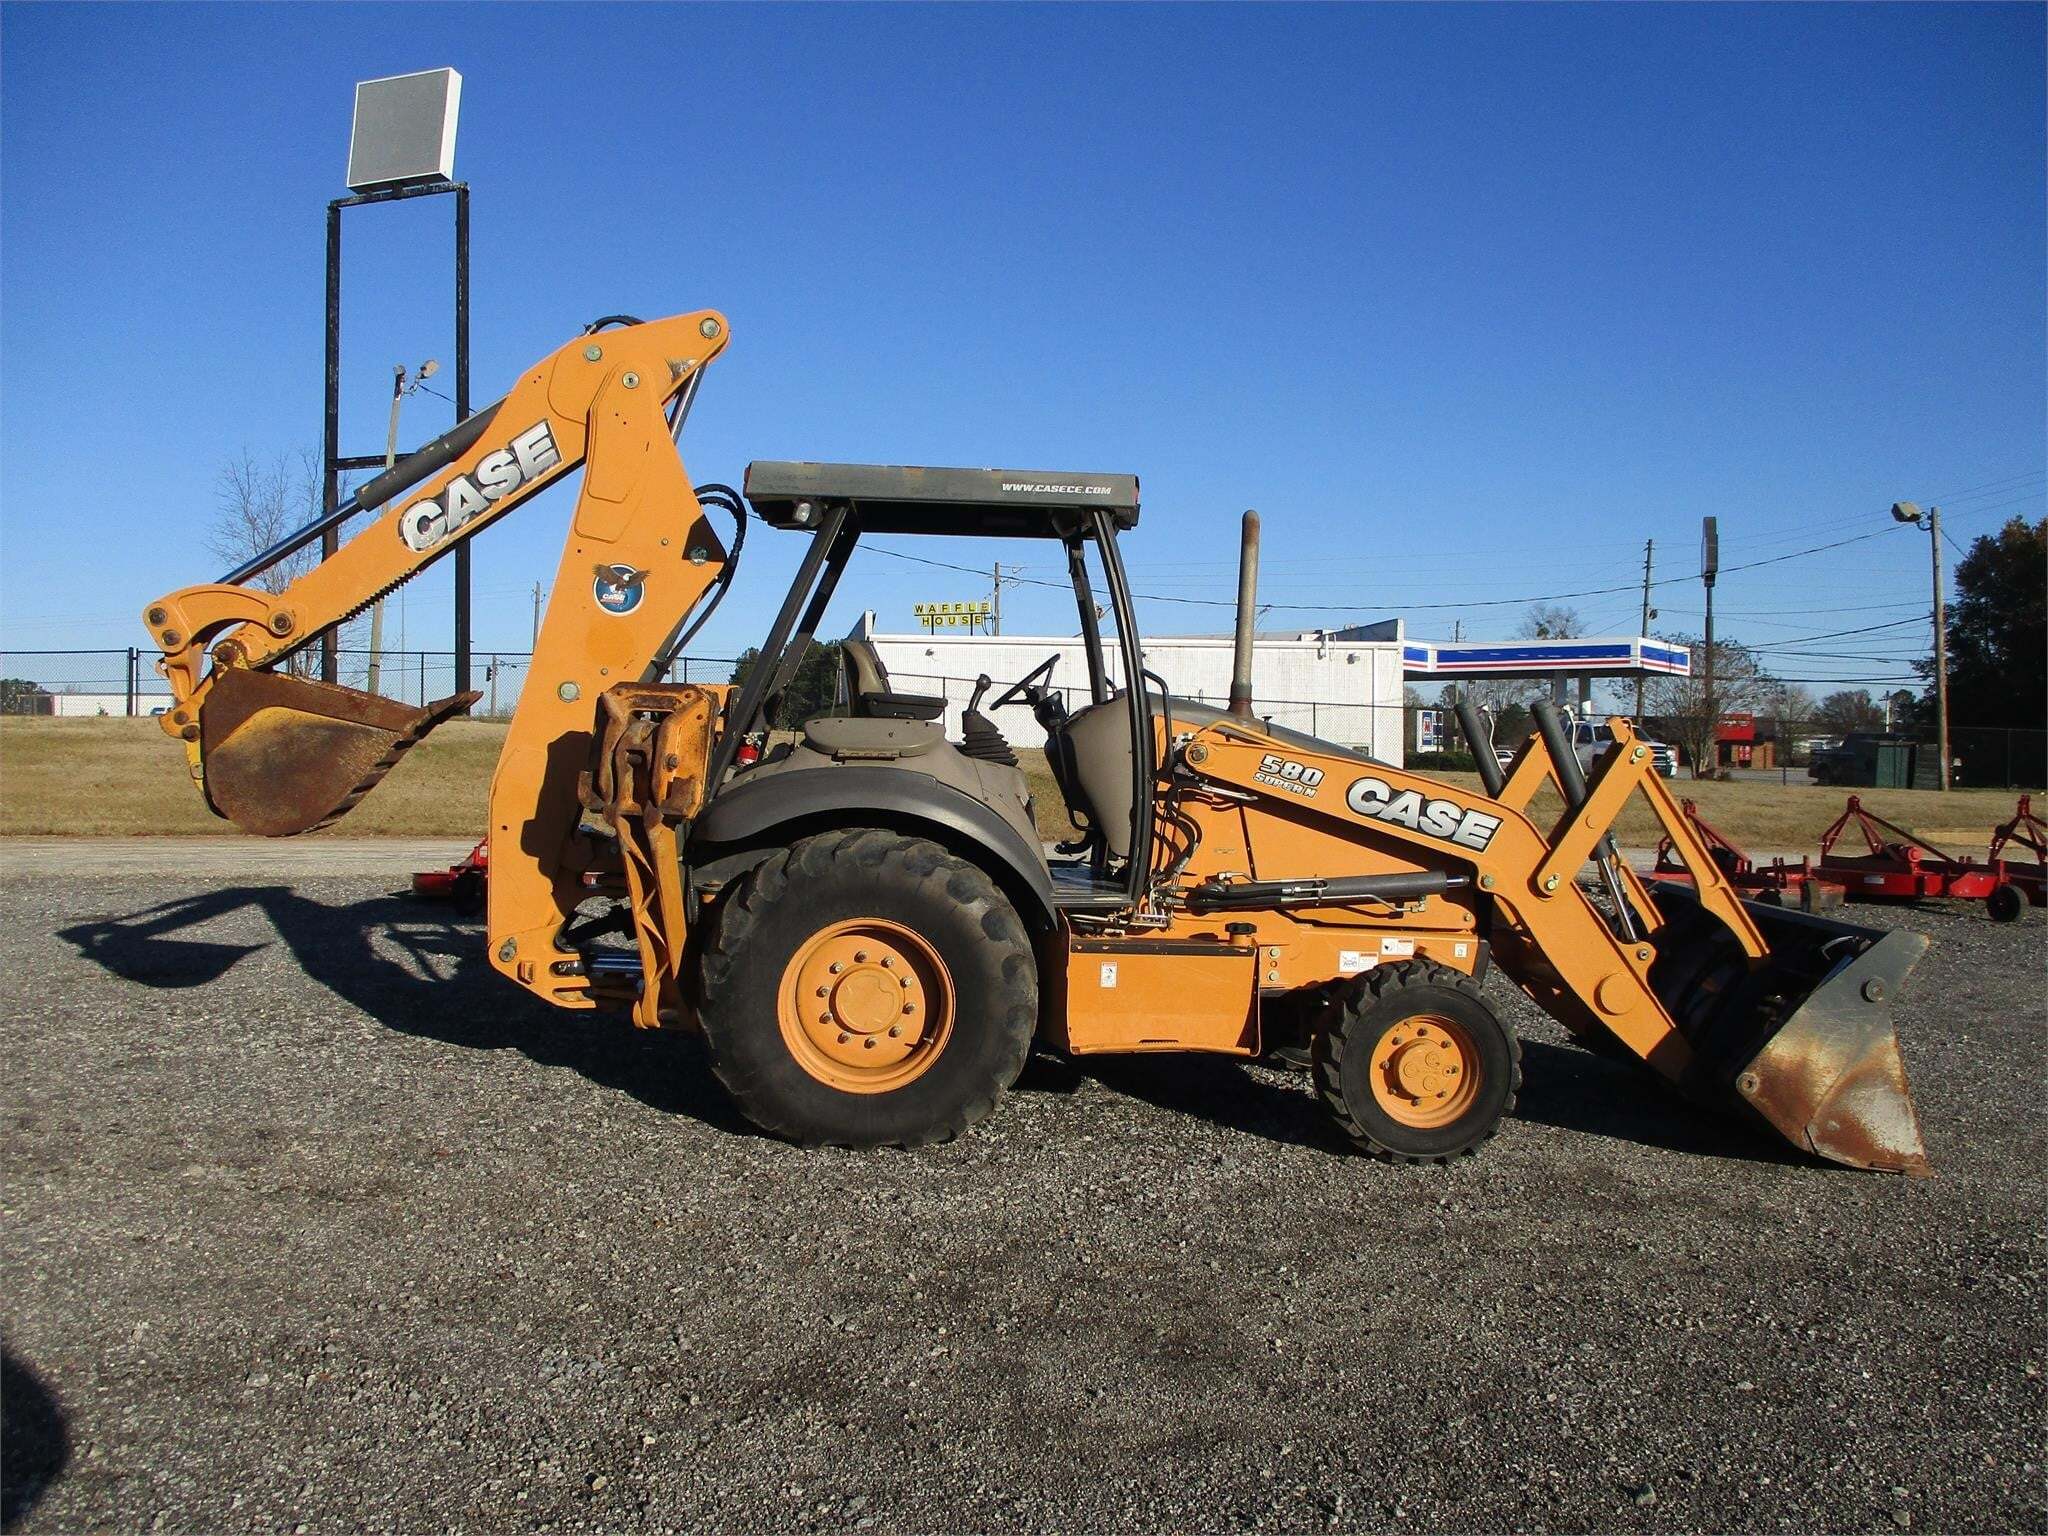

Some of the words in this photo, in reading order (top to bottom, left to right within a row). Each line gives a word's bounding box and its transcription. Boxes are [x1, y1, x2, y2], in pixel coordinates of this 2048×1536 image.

[401, 419, 562, 552] CASE
[1002, 483, 1112, 495] WWW.CASECE.COM
[915, 603, 990, 613] WAFFLE
[922, 616, 982, 625] HOUSE
[1259, 754, 1325, 787] 580
[1253, 772, 1304, 794] SUPER
[1346, 777, 1502, 852] CASE
